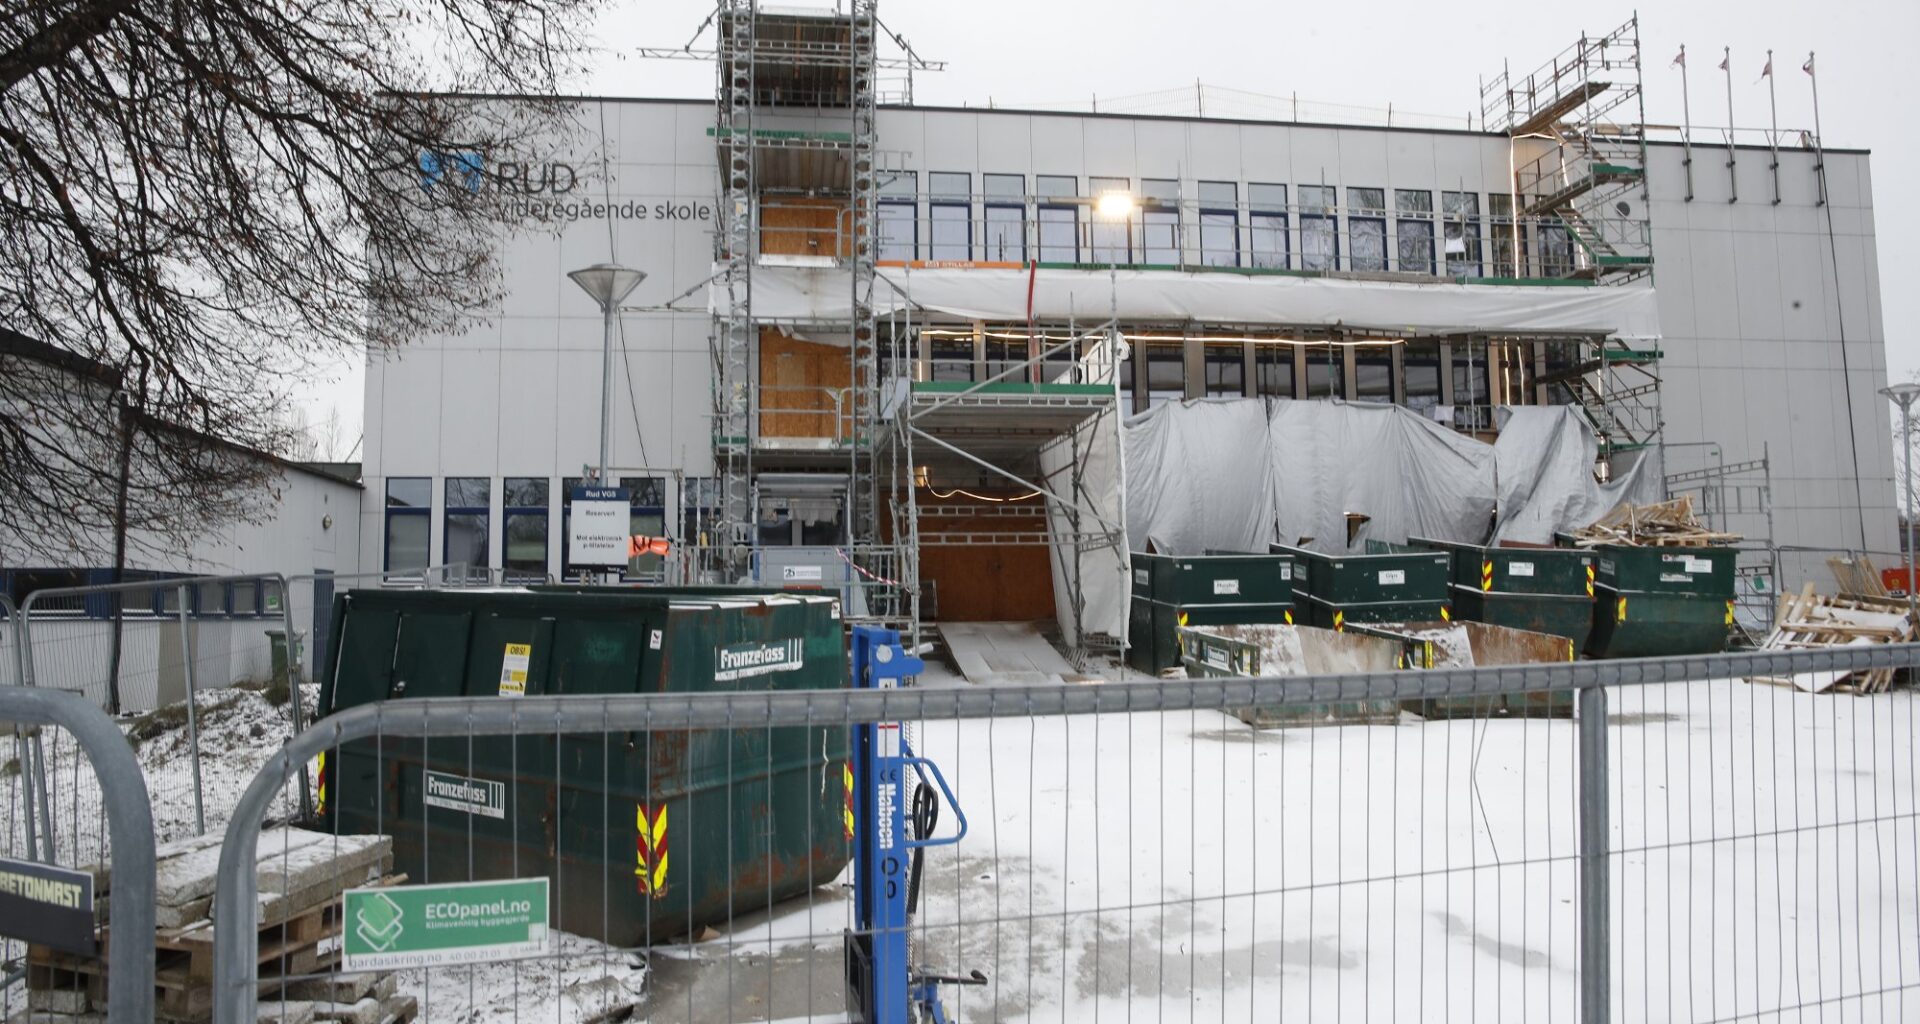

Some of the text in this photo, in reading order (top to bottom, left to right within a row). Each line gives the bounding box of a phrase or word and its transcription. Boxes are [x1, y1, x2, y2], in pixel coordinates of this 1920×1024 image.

[498, 162, 575, 193] RUD
[498, 198, 710, 222] videregående skole
[510, 646, 526, 656] OBS!
[720, 643, 784, 669] Franzefoss
[428, 776, 486, 803] Franzefoss
[0, 871, 82, 909] BETONMAST
[425, 899, 531, 919] ECOpanel.no
[425, 918, 479, 929] Klimavennlig
[351, 953, 442, 969] gardasikring.no
[464, 951, 476, 960] 00
[479, 950, 488, 959] 21
[490, 949, 500, 958] 01
